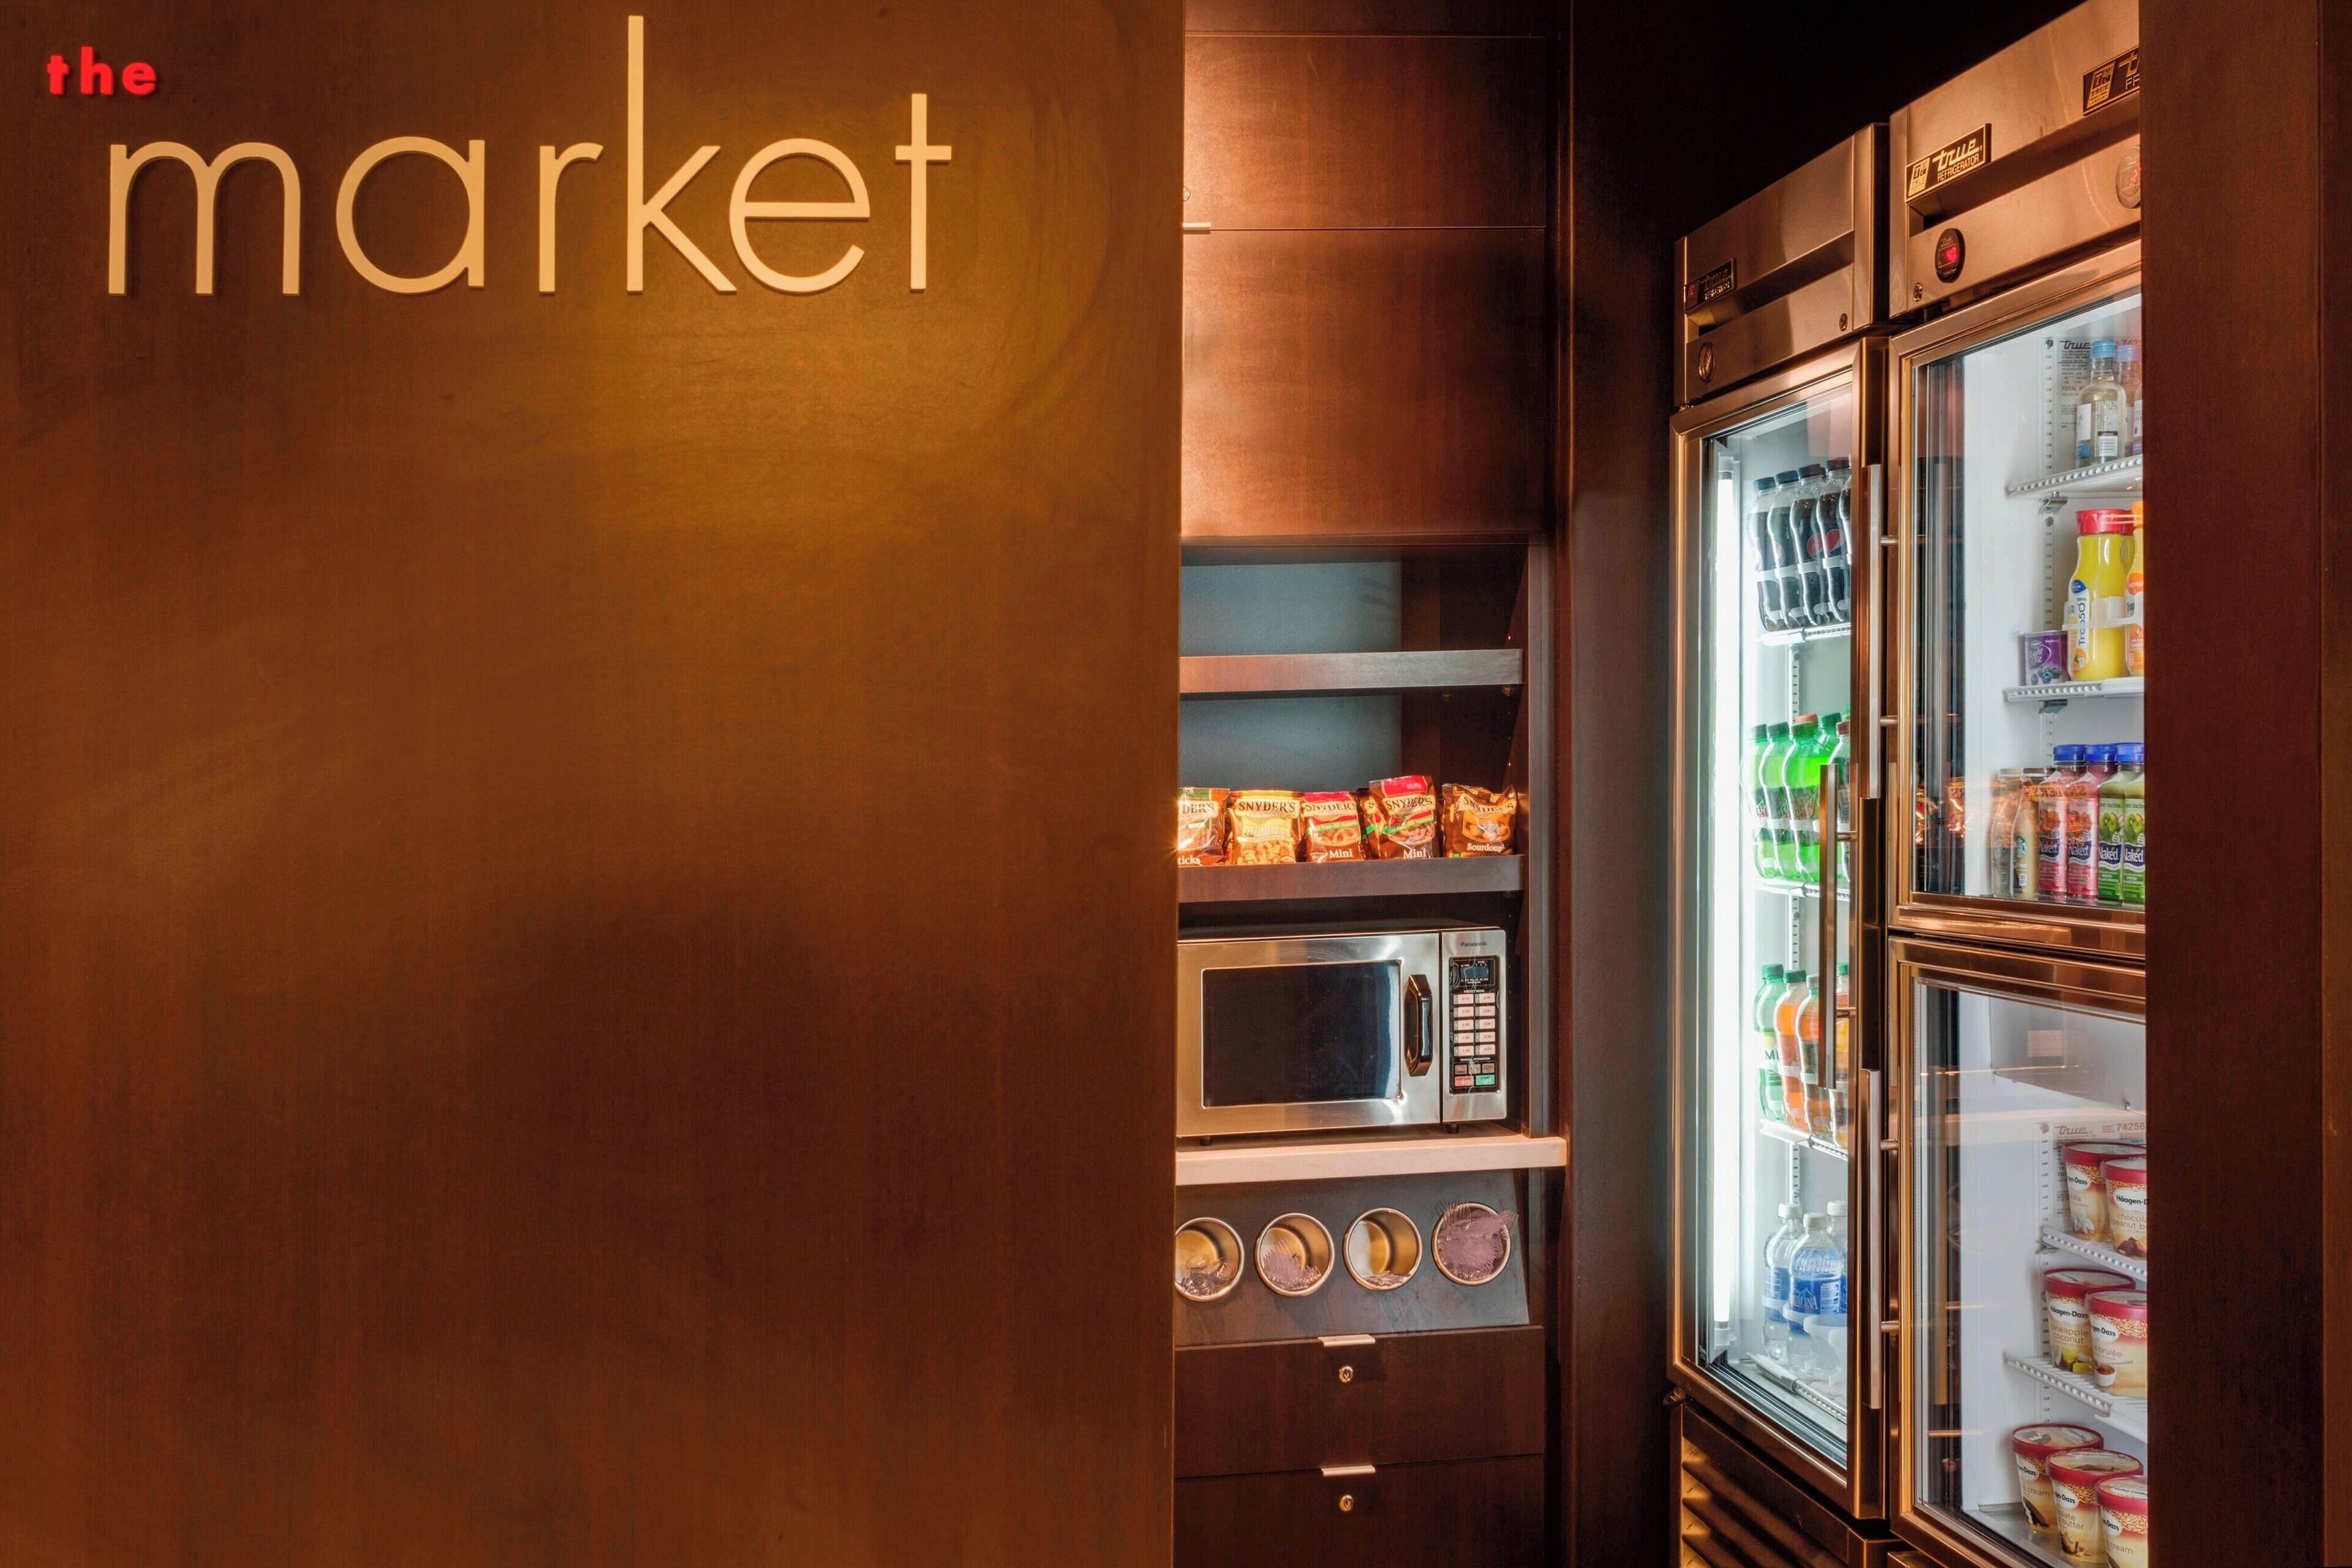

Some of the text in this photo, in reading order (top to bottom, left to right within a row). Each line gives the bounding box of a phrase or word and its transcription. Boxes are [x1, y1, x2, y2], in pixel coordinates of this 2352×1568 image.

[47, 46, 157, 96] the
[108, 15, 952, 296] market
[1932, 138, 1980, 172] true
[1937, 153, 1980, 182] REFRIGERATOR
[2060, 339, 2092, 349] true
[1182, 802, 1215, 815] DER'S
[1238, 801, 1296, 813] SNYDER'S
[1306, 802, 1357, 812] SNYDER'S
[1385, 797, 1433, 810] SNYDER'S
[1330, 849, 1353, 858] Mini
[1403, 848, 1427, 858] Mini
[2069, 845, 2089, 856] Naked
[2099, 848, 2119, 861] Naked
[1178, 855, 1201, 864] ticks
[2055, 1125, 2089, 1135] true
[2116, 1195, 2148, 1205] Häagen-D
[2053, 1334, 2084, 1344] coconut
[2098, 1346, 2123, 1358] brulée
[2027, 1487, 2050, 1498] cream
[2063, 1518, 2084, 1531] butter
[2109, 1542, 2133, 1555] cream
